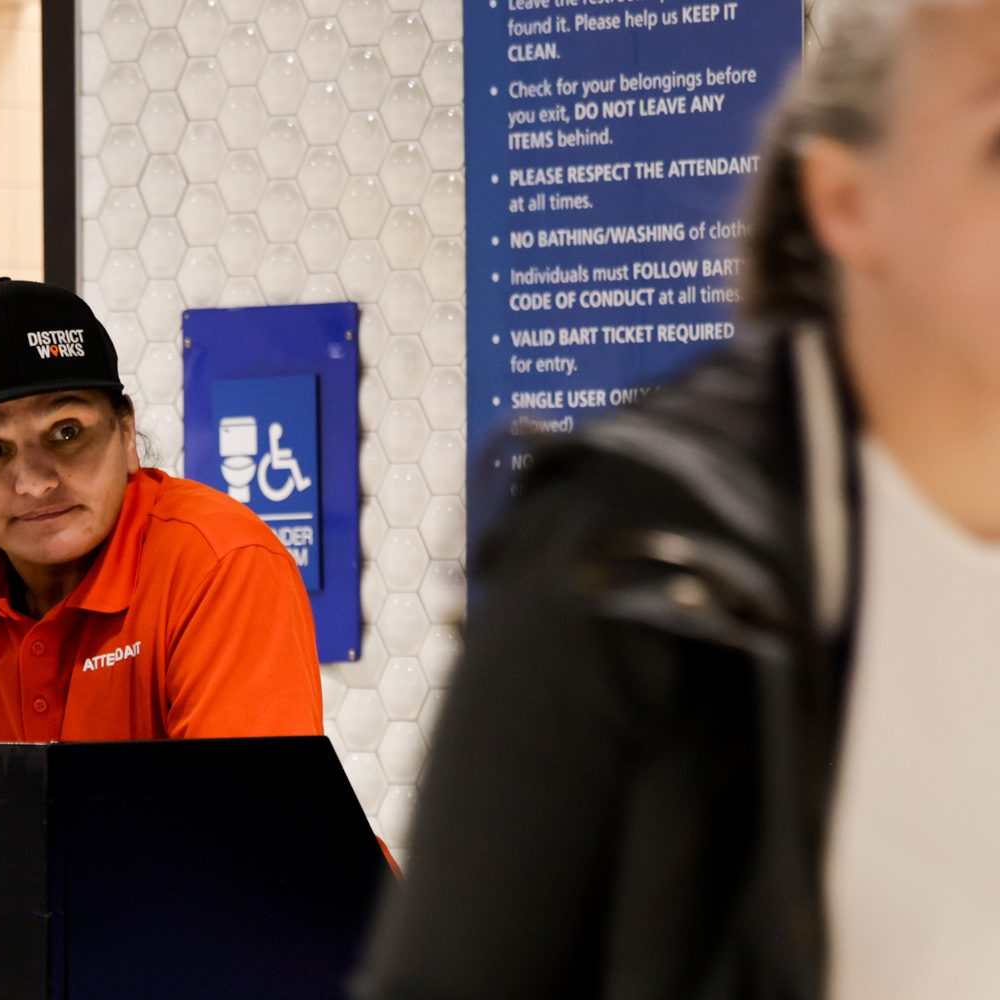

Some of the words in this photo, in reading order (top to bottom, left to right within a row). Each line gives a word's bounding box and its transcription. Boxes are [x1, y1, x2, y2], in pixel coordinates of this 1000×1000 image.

[508, 16, 551, 36] found
[556, 16, 570, 33] it.
[575, 14, 620, 31] Please
[625, 9, 657, 30] help
[662, 11, 678, 25] us
[682, 5, 720, 24] KEEP
[724, 3, 738, 20] IT
[508, 43, 560, 62] CLEAN.
[509, 78, 552, 98] Check
[556, 77, 578, 95] for
[582, 79, 616, 98] your
[620, 71, 702, 93] belongings
[706, 66, 757, 86] before
[508, 111, 535, 128] you
[539, 105, 570, 124] exit,
[575, 103, 598, 120] DO
[602, 100, 635, 118] NOT
[639, 96, 686, 116] LEAVE
[690, 94, 725, 113] ANY
[508, 131, 553, 150] ITEMS
[558, 126, 613, 147] behind.
[510, 166, 563, 187] PLEASE
[567, 163, 630, 183] RESPECT
[634, 161, 664, 180] THE
[668, 156, 760, 178] ATTENDANT
[509, 197, 524, 213] at
[528, 193, 546, 211] all
[550, 193, 593, 211] times.
[510, 231, 534, 249] NO
[538, 224, 685, 248] BATHING/WASHING
[689, 221, 706, 240] of
[511, 264, 589, 285] Individuals
[593, 264, 629, 281] must
[633, 260, 698, 280] FOLLOW
[510, 293, 551, 311] CODE
[555, 291, 577, 309] OF
[579, 288, 655, 308] CONDUCT
[658, 289, 674, 305] at
[678, 286, 696, 304] all
[27, 329, 84, 346] DISTRICT
[511, 329, 555, 347] VALID
[559, 327, 598, 346] BART
[601, 325, 654, 344] TICKET
[657, 323, 735, 343] REQUIRED
[511, 355, 532, 373] for
[536, 356, 578, 376] entry.
[511, 390, 564, 409] SINGLE
[568, 389, 606, 408] USER
